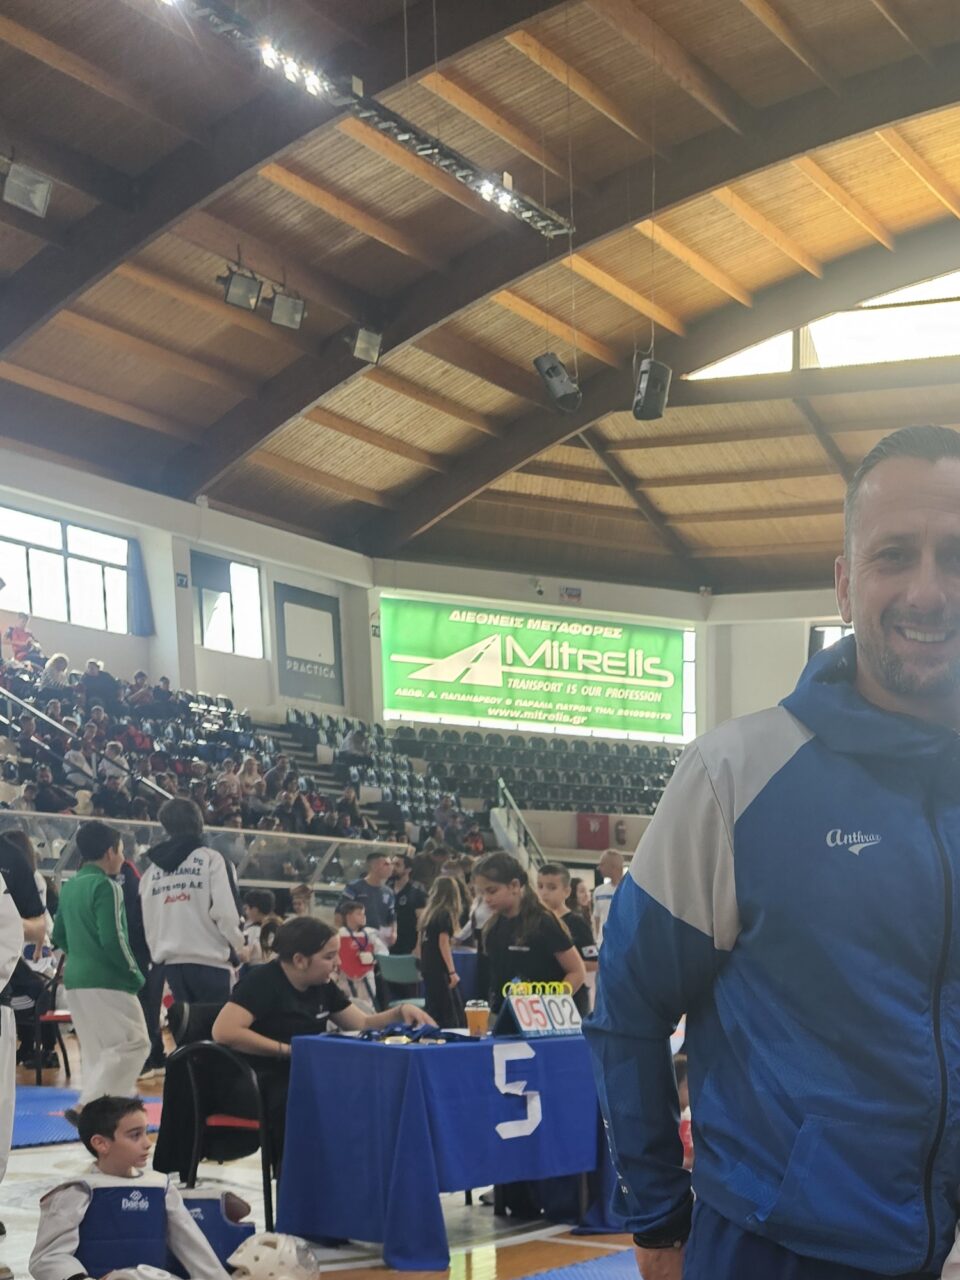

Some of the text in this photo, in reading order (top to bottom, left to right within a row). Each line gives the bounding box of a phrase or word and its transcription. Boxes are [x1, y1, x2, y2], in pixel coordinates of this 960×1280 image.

[449, 609, 623, 639] ΔΙΕΘΝΕΙΣ ΜΕΤΑΦΟΡΕΣ
[286, 660, 336, 679] PRACTICA
[507, 678, 662, 703] TRANSPORT IS OUR PROFESSION
[515, 998, 581, 1028] 05 02
[493, 1042, 543, 1140] 5
